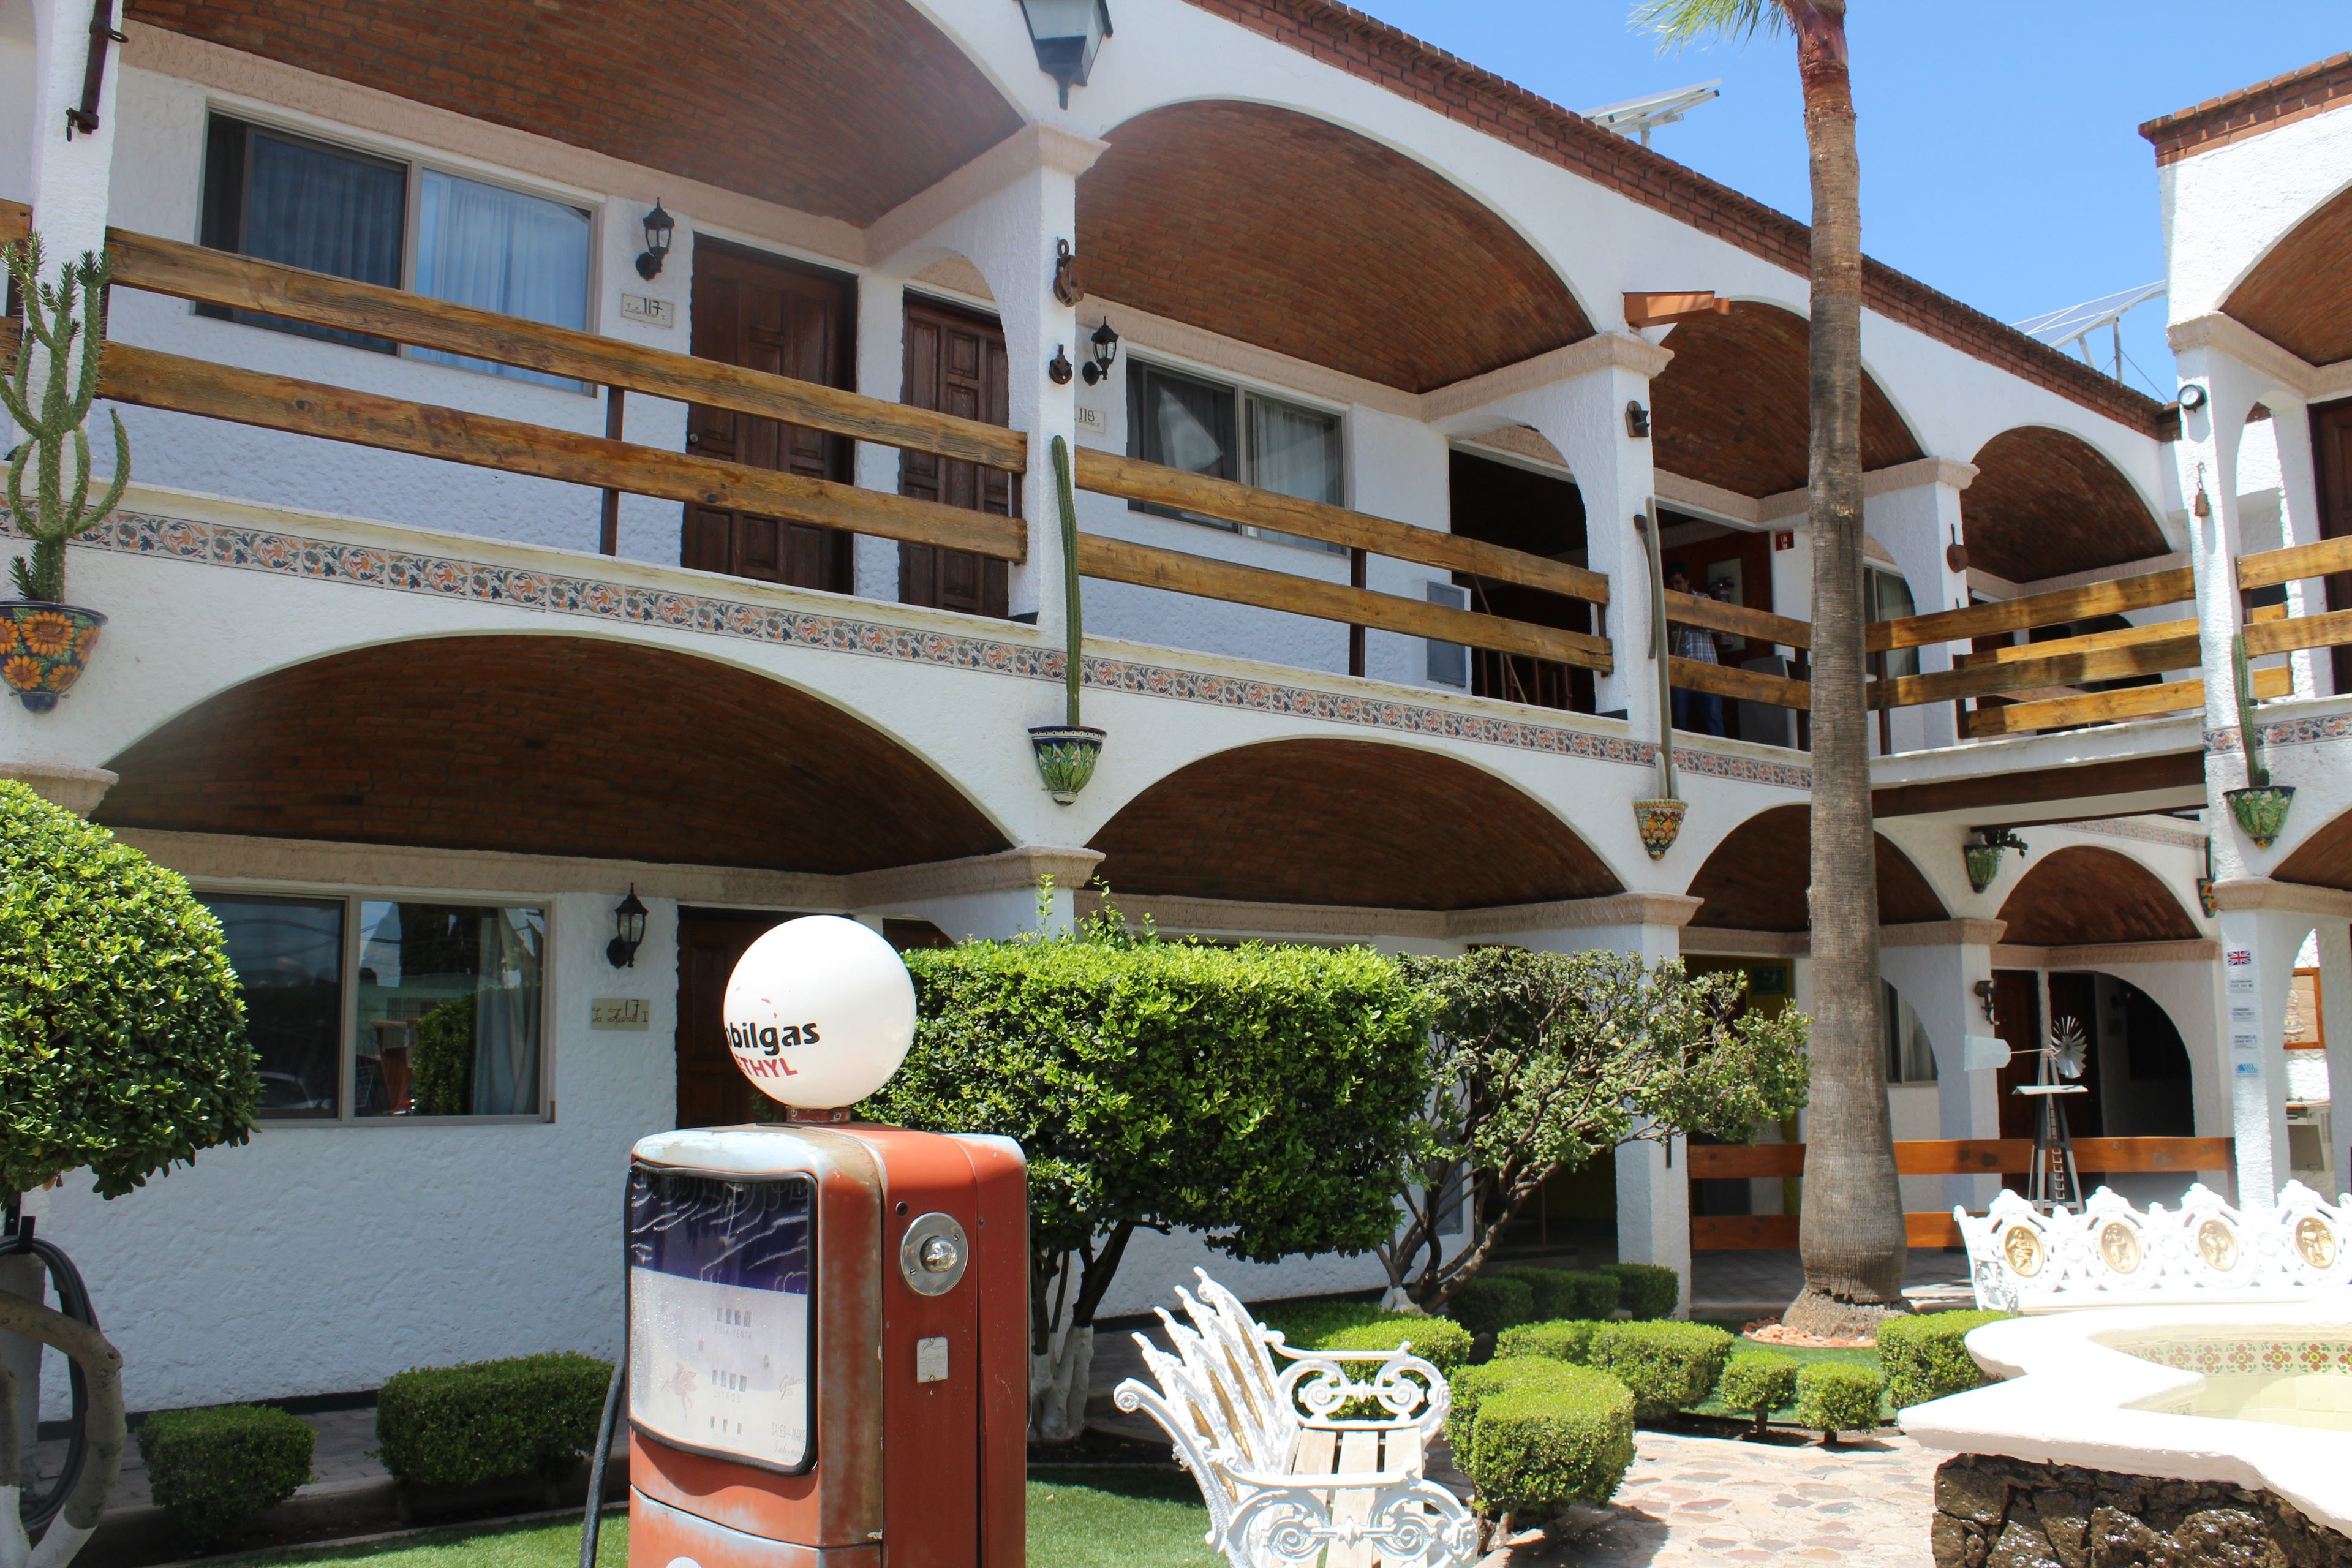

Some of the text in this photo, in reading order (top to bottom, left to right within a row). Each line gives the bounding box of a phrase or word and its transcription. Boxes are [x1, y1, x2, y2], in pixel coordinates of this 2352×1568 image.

[644, 298, 663, 315] 117
[1079, 407, 1095, 421] 118
[625, 999, 640, 1017] 17
[714, 1390, 741, 1403] LITROS
